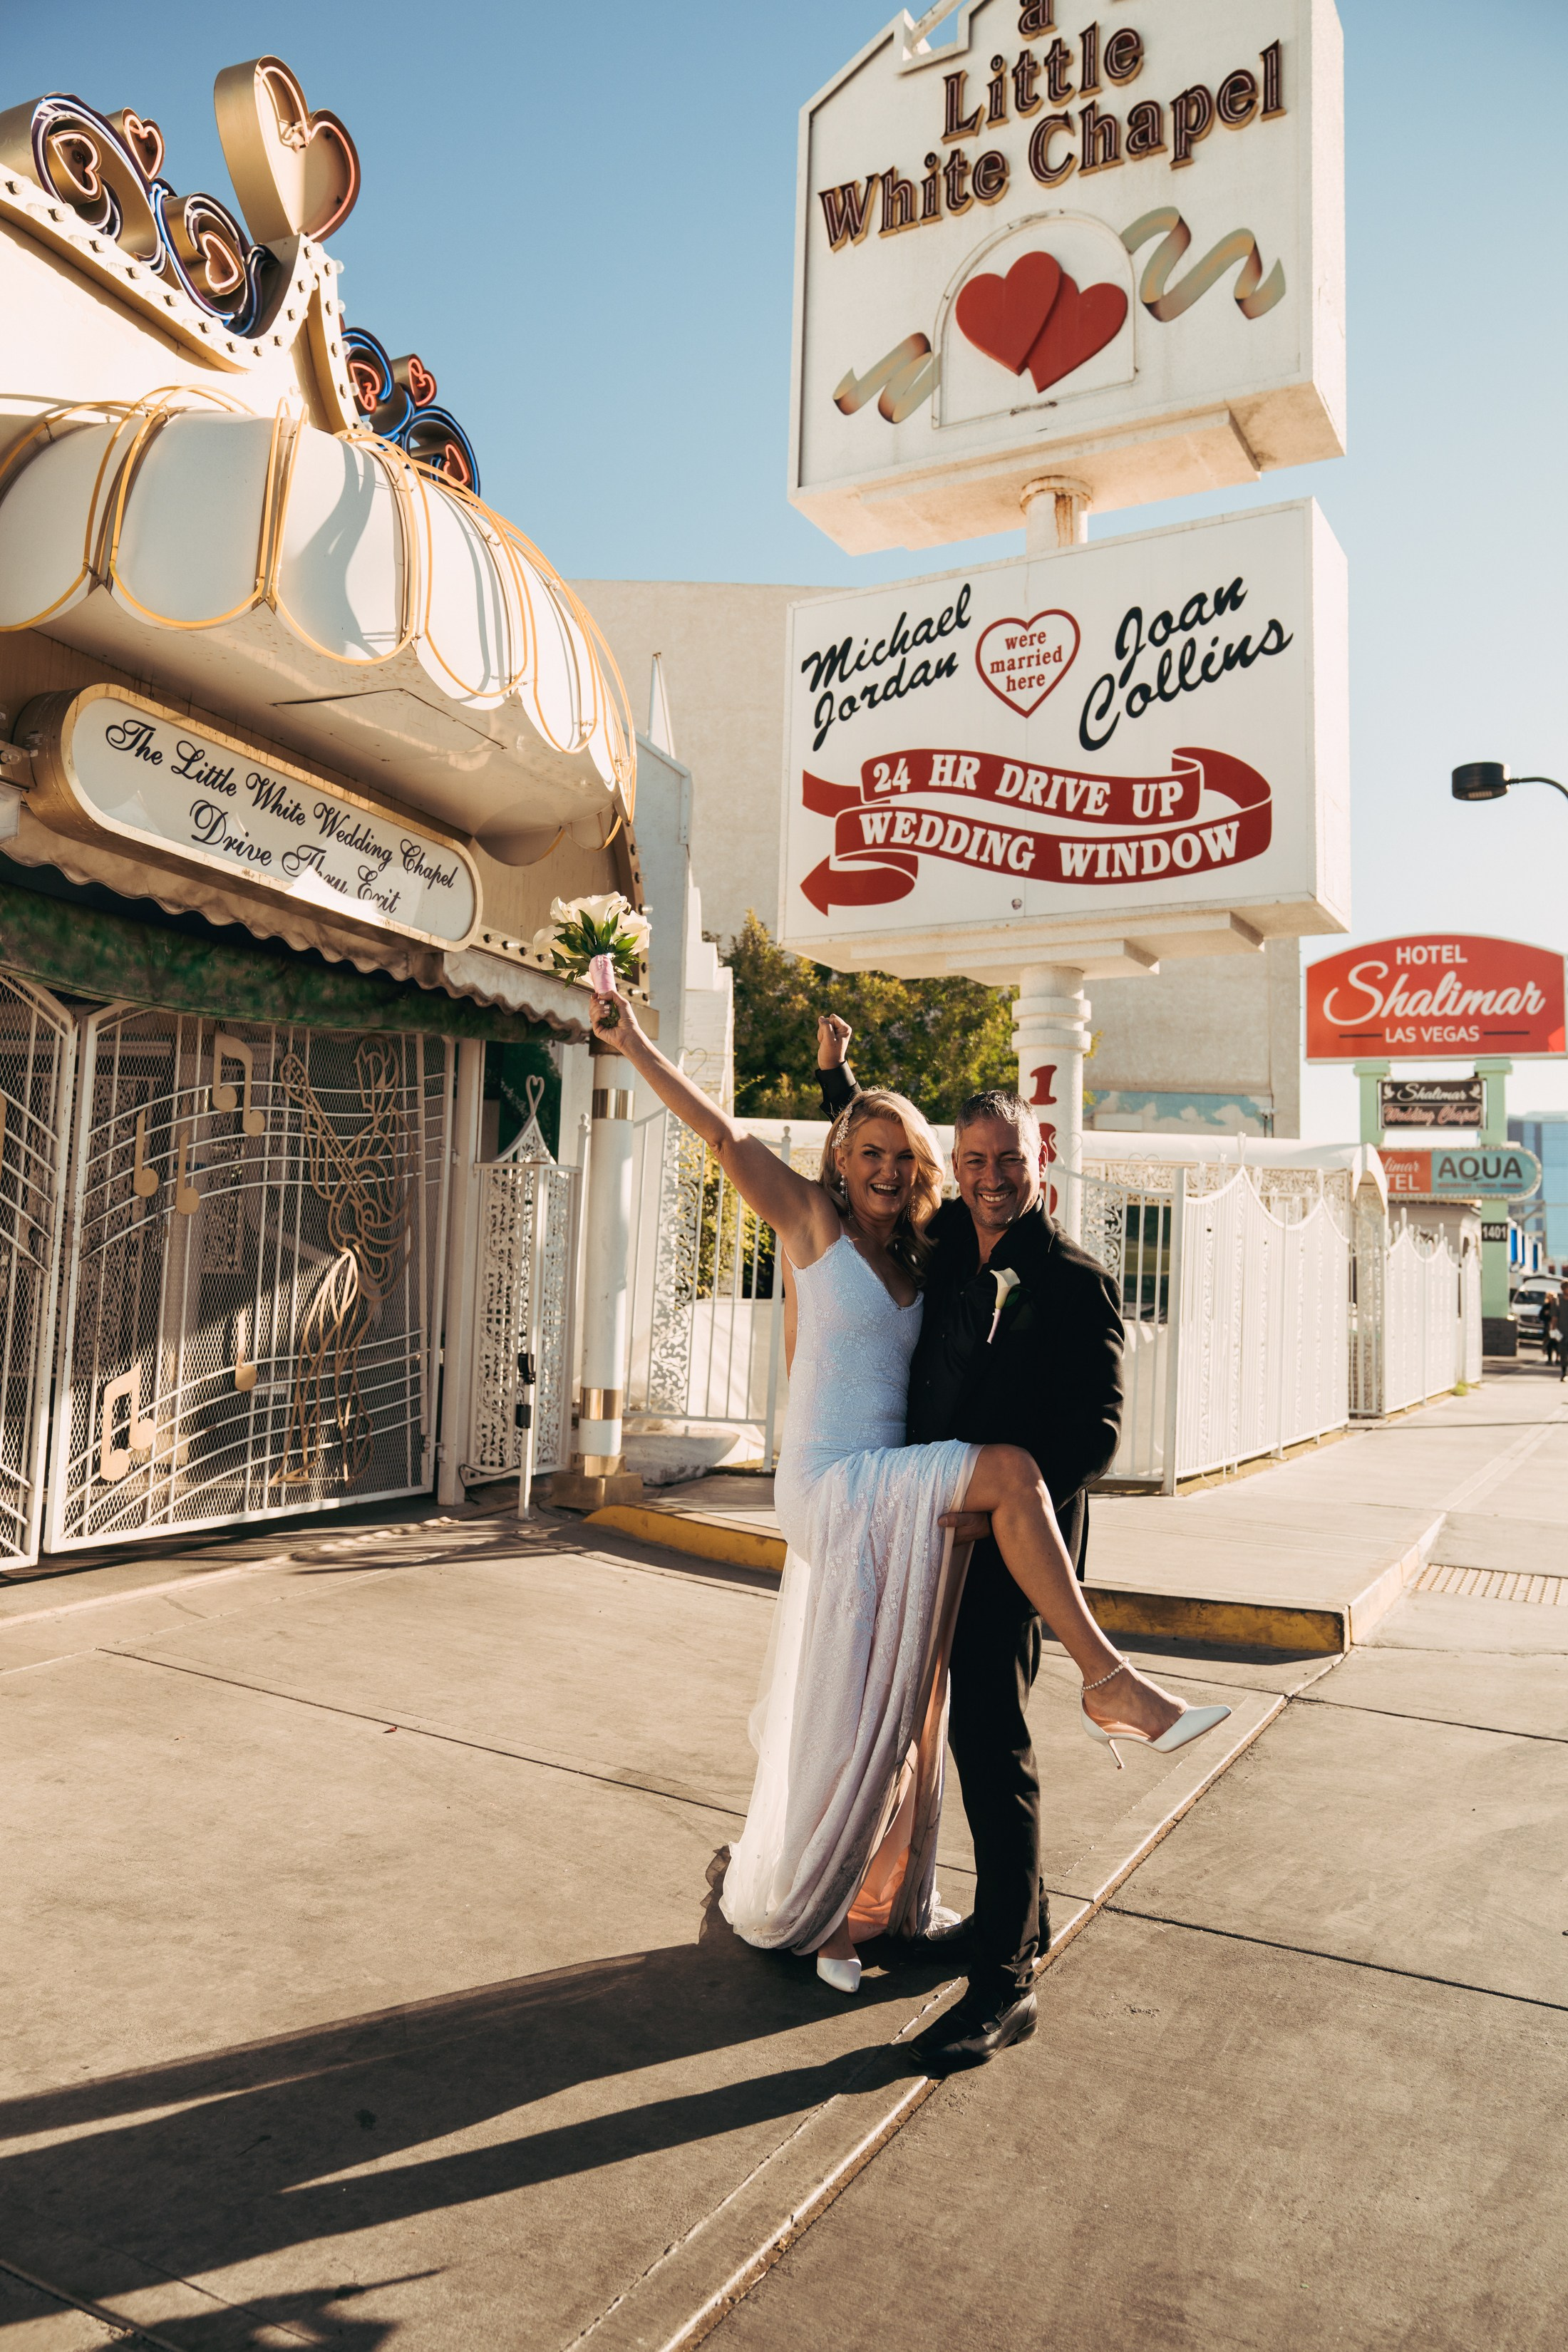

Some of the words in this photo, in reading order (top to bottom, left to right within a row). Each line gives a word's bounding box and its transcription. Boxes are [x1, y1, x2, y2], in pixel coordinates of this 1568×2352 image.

[941, 21, 1144, 143] Little
[819, 148, 1010, 252] White
[1028, 38, 1286, 188] Chapel
[801, 583, 971, 692] Michael
[990, 645, 1063, 674] married
[1005, 631, 1046, 650] were
[1115, 577, 1249, 688] Joan
[812, 651, 959, 751] Jordan
[1006, 674, 1046, 692] here
[1078, 619, 1294, 751] Collins
[105, 719, 163, 765] The
[170, 740, 237, 797] Little
[245, 772, 306, 826] White
[314, 802, 393, 872] Wedding
[400, 838, 459, 890] Chapel
[872, 758, 912, 793] 24
[929, 753, 981, 790] HR
[995, 764, 1110, 817] DRIVE
[1131, 781, 1185, 818] UP
[190, 799, 272, 866] Drive
[358, 865, 401, 914] Exit
[859, 812, 1036, 872] WEDDING
[1058, 820, 1241, 879] WINDOW
[1396, 945, 1468, 965] HOTEL
[1323, 960, 1546, 1026] Shalimar
[1386, 1026, 1417, 1043] LAS
[1420, 1026, 1480, 1043] VEGAS
[1397, 1083, 1467, 1102] Shalimar
[1383, 1156, 1420, 1173] limar
[1385, 1173, 1420, 1191] TEL
[1438, 1156, 1523, 1182] AQUA
[1482, 1224, 1507, 1239] 1401
